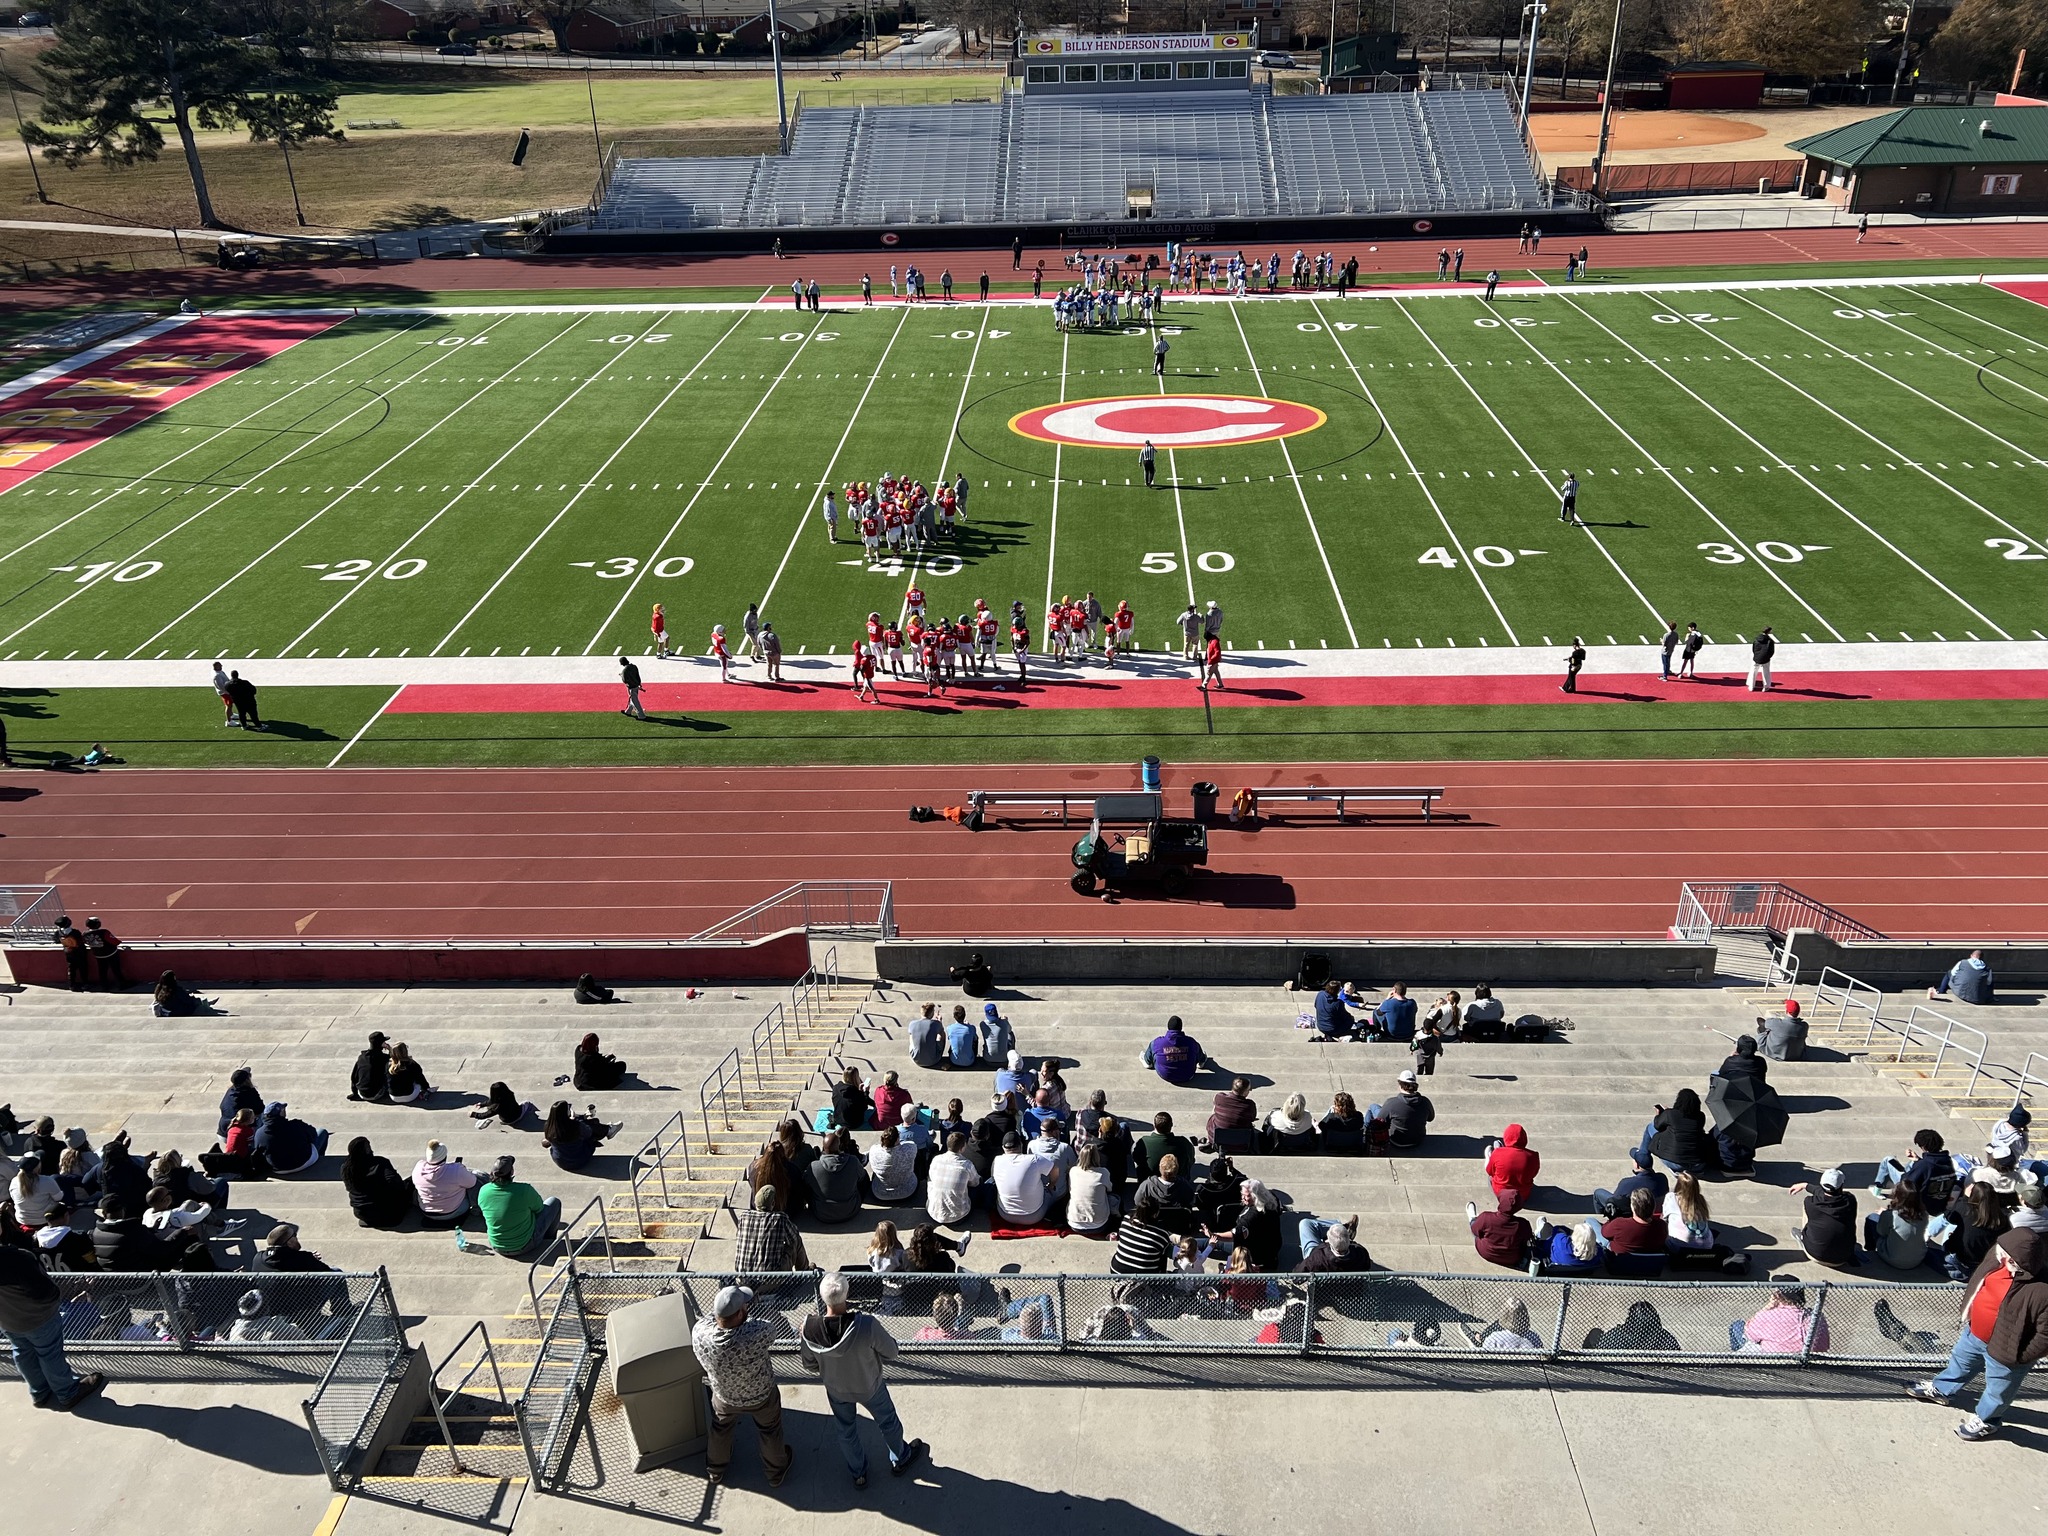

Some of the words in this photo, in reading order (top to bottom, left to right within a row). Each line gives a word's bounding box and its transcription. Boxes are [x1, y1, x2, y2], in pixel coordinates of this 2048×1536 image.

[1065, 41, 1093, 52] BILLY
[1095, 39, 1160, 51] HENDERSON
[1162, 38, 1211, 49] STADIUM
[1067, 226, 1105, 235] CLARKE
[1107, 225, 1153, 234] CENTRAL
[1154, 223, 1216, 234] GLADATORS
[1042, 398, 1286, 444] C
[866, 522, 875, 530] 13
[1417, 545, 1515, 568] 40
[1696, 541, 1804, 564] 30
[1984, 538, 2048, 560] 2
[73, 561, 164, 583] 10
[319, 559, 428, 581] 20
[595, 557, 695, 578] 30
[867, 555, 963, 577] 40
[1139, 551, 1236, 574] 50
[910, 592, 921, 600] 20
[985, 624, 995, 632] 99
